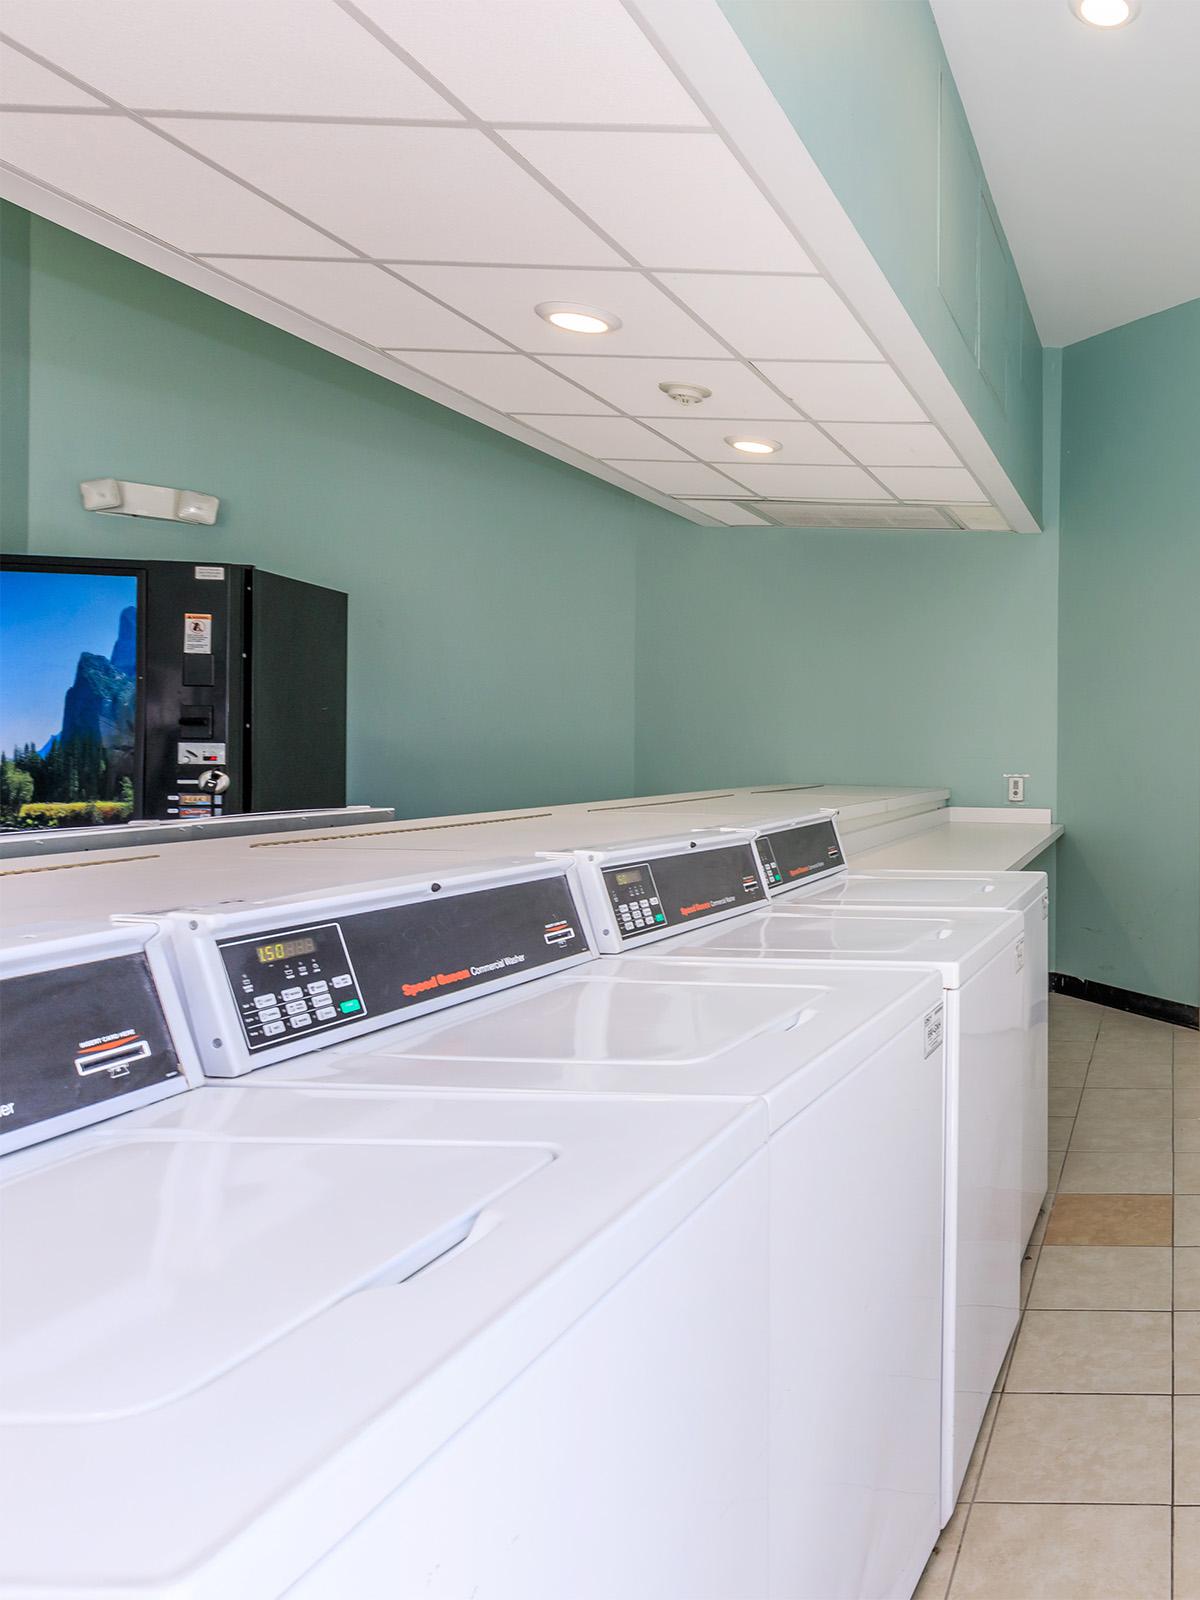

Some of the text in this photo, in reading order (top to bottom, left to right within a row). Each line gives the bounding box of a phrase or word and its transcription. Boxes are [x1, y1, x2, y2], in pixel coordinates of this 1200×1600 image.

[258, 943, 285, 963] 150
[402, 976, 439, 996] Speed
[470, 959, 505, 976] Commercial
[504, 954, 525, 967] Washer
